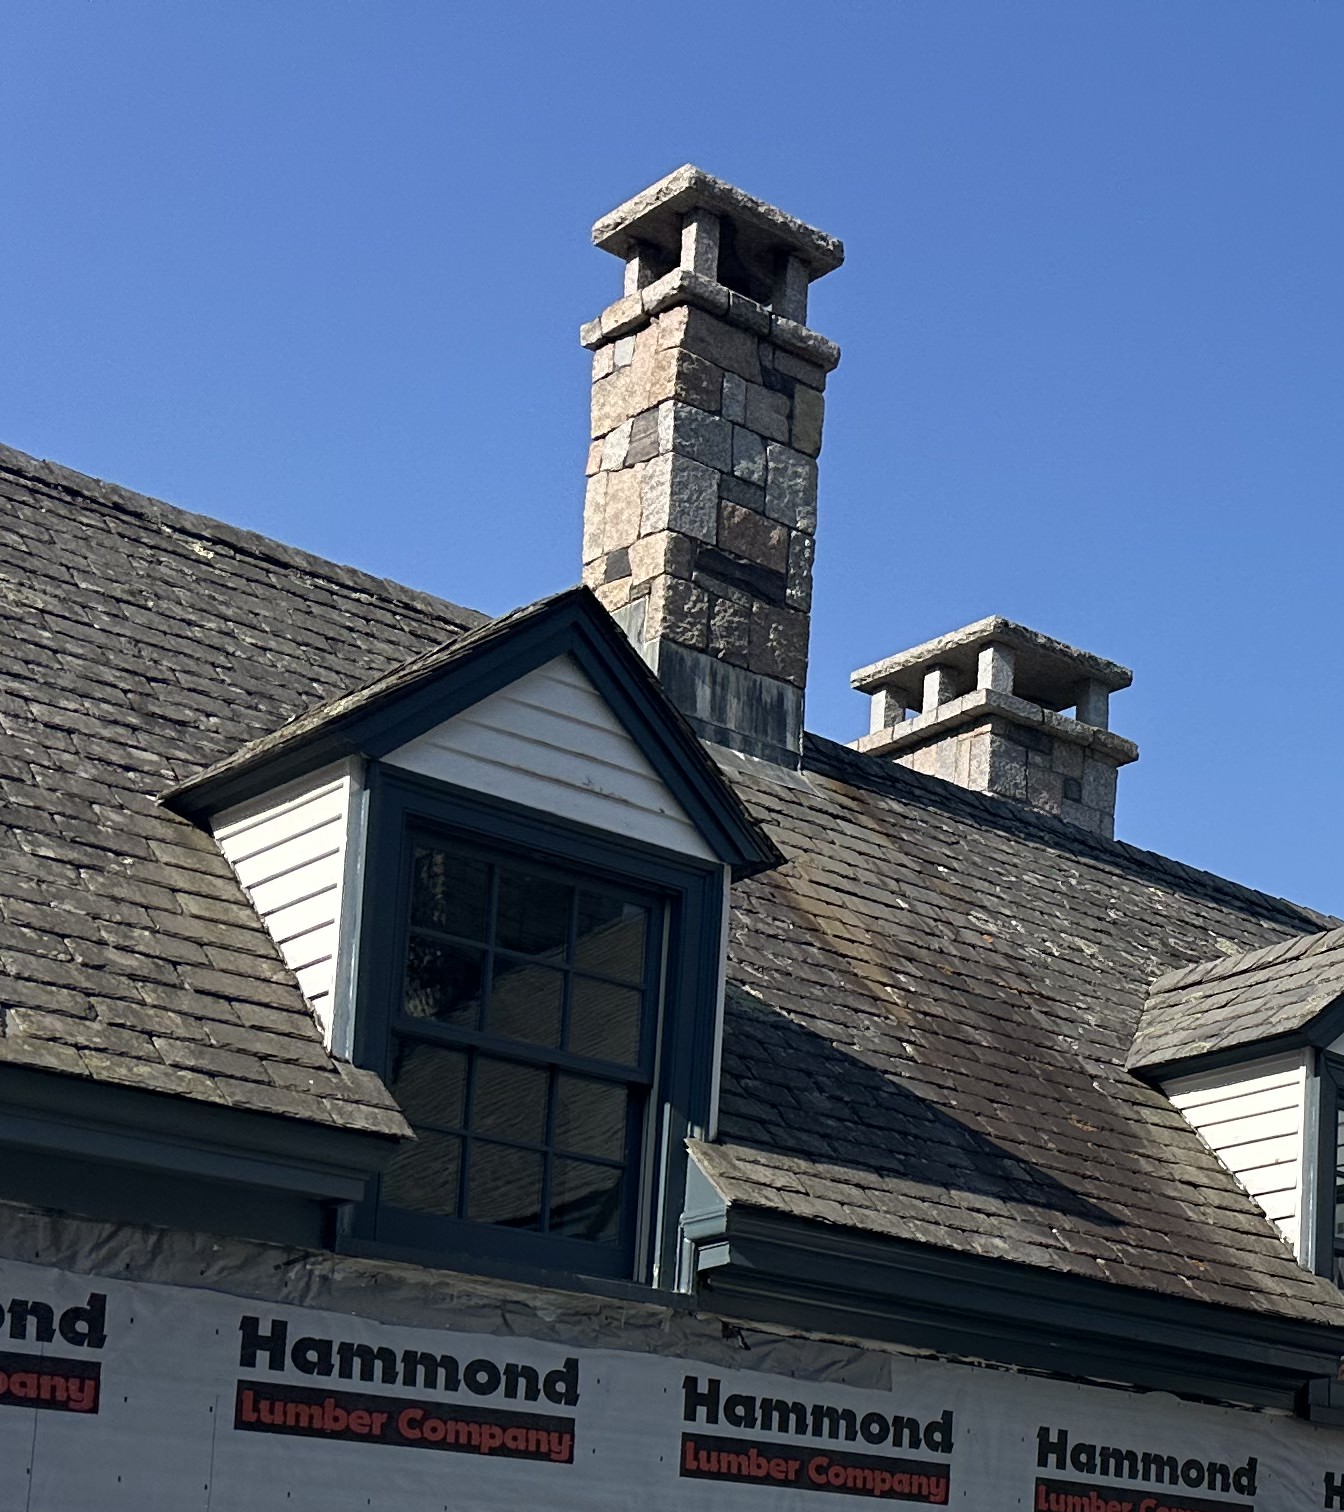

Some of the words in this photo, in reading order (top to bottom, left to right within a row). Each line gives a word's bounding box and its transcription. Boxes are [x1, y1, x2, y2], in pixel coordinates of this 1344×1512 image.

[238, 1315, 580, 1407] Hammond
[241, 1389, 389, 1436] Lumber
[398, 1407, 574, 1461] Company
[681, 1375, 954, 1454] Hammond
[684, 1440, 800, 1482] Lumber
[807, 1456, 948, 1503] Company
[1036, 1426, 1258, 1496] Hammond
